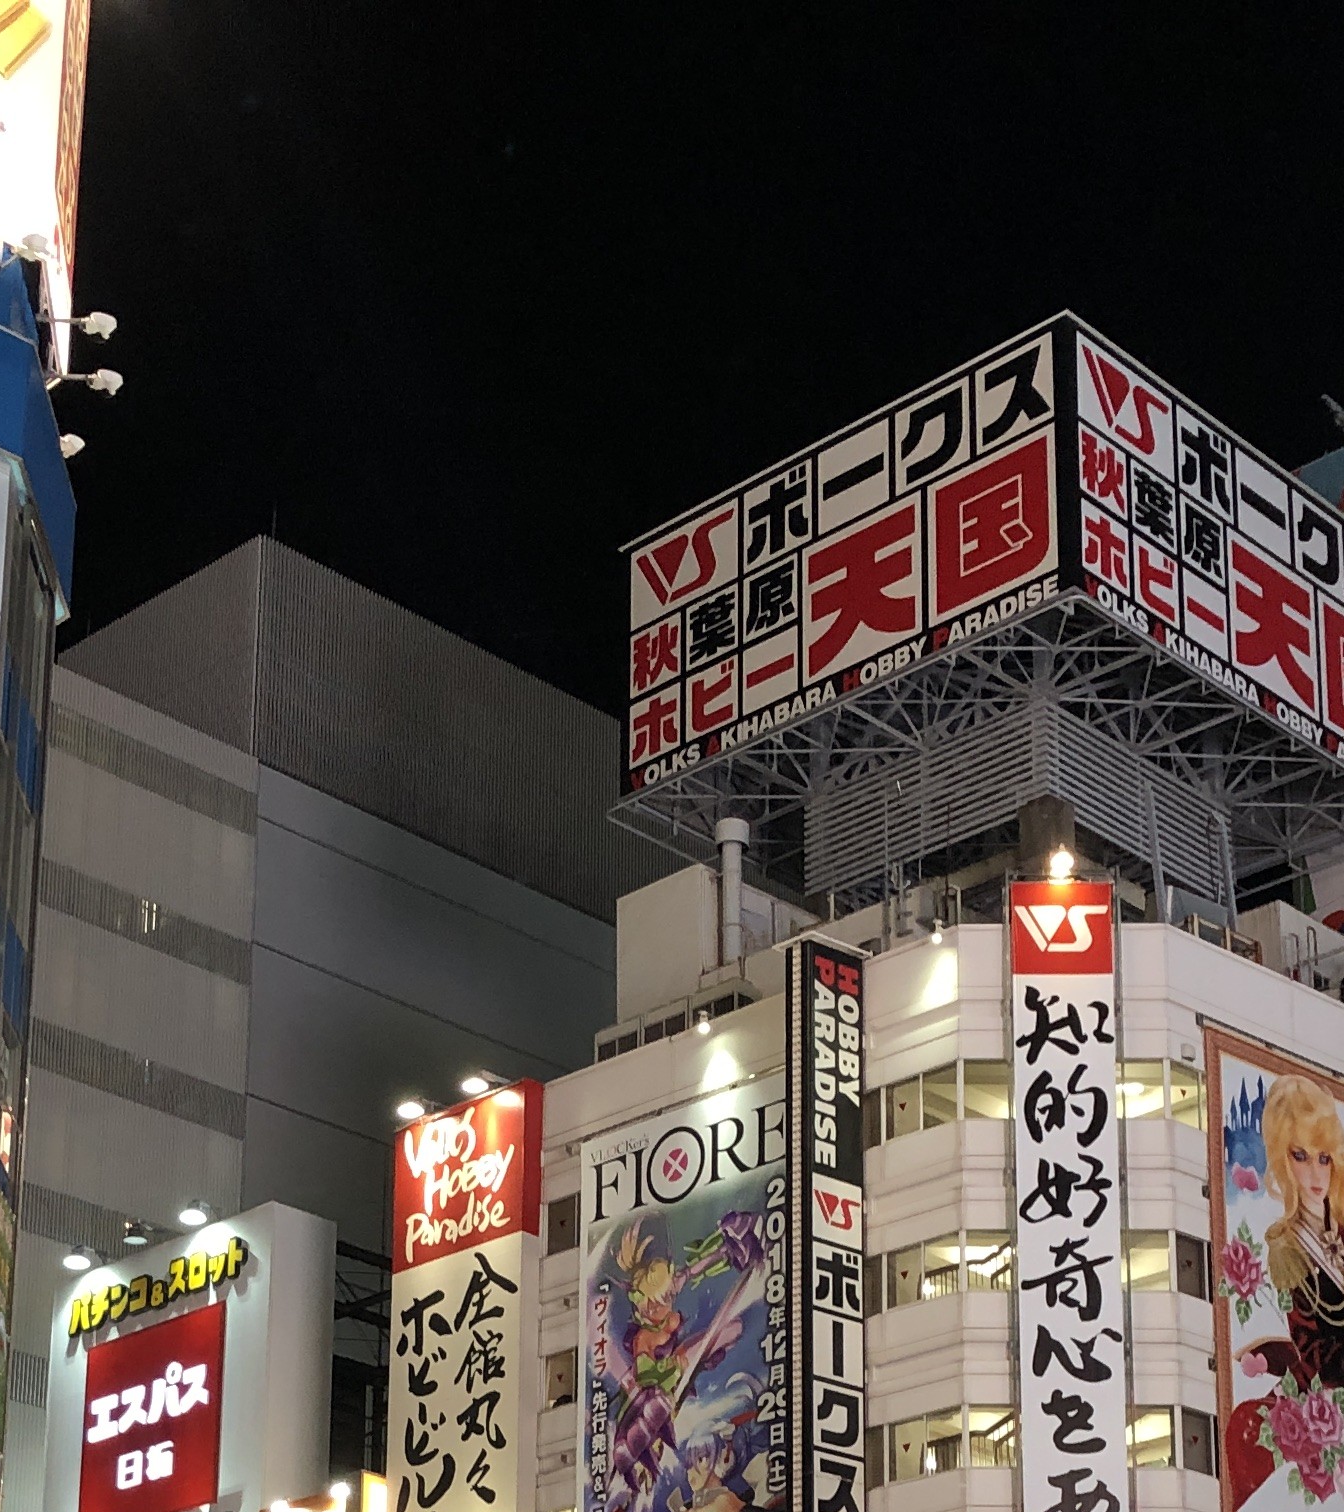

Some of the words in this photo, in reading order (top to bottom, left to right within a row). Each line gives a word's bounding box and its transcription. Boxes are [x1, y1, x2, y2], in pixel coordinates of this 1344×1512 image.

[747, 344, 1052, 566] ボークス
[1081, 429, 1224, 582] 秋葉原
[630, 746, 701, 792] VOLKS
[706, 680, 837, 756] AKIHABARA
[842, 636, 929, 692] HOBBY
[933, 573, 1060, 652] PARADISE
[633, 560, 795, 691] 秋葉原
[1084, 573, 1149, 634] VOLKS
[1152, 624, 1258, 704] AKIHABARA
[1263, 692, 1323, 748] HOBBY
[813, 956, 838, 1167] PARADISE
[835, 962, 861, 1107] HOBBY
[406, 1195, 511, 1263] Paradise
[590, 1100, 788, 1224] FIORE
[69, 1236, 249, 1339] パチンコ&スロット
[87, 1361, 210, 1444] エスパス
